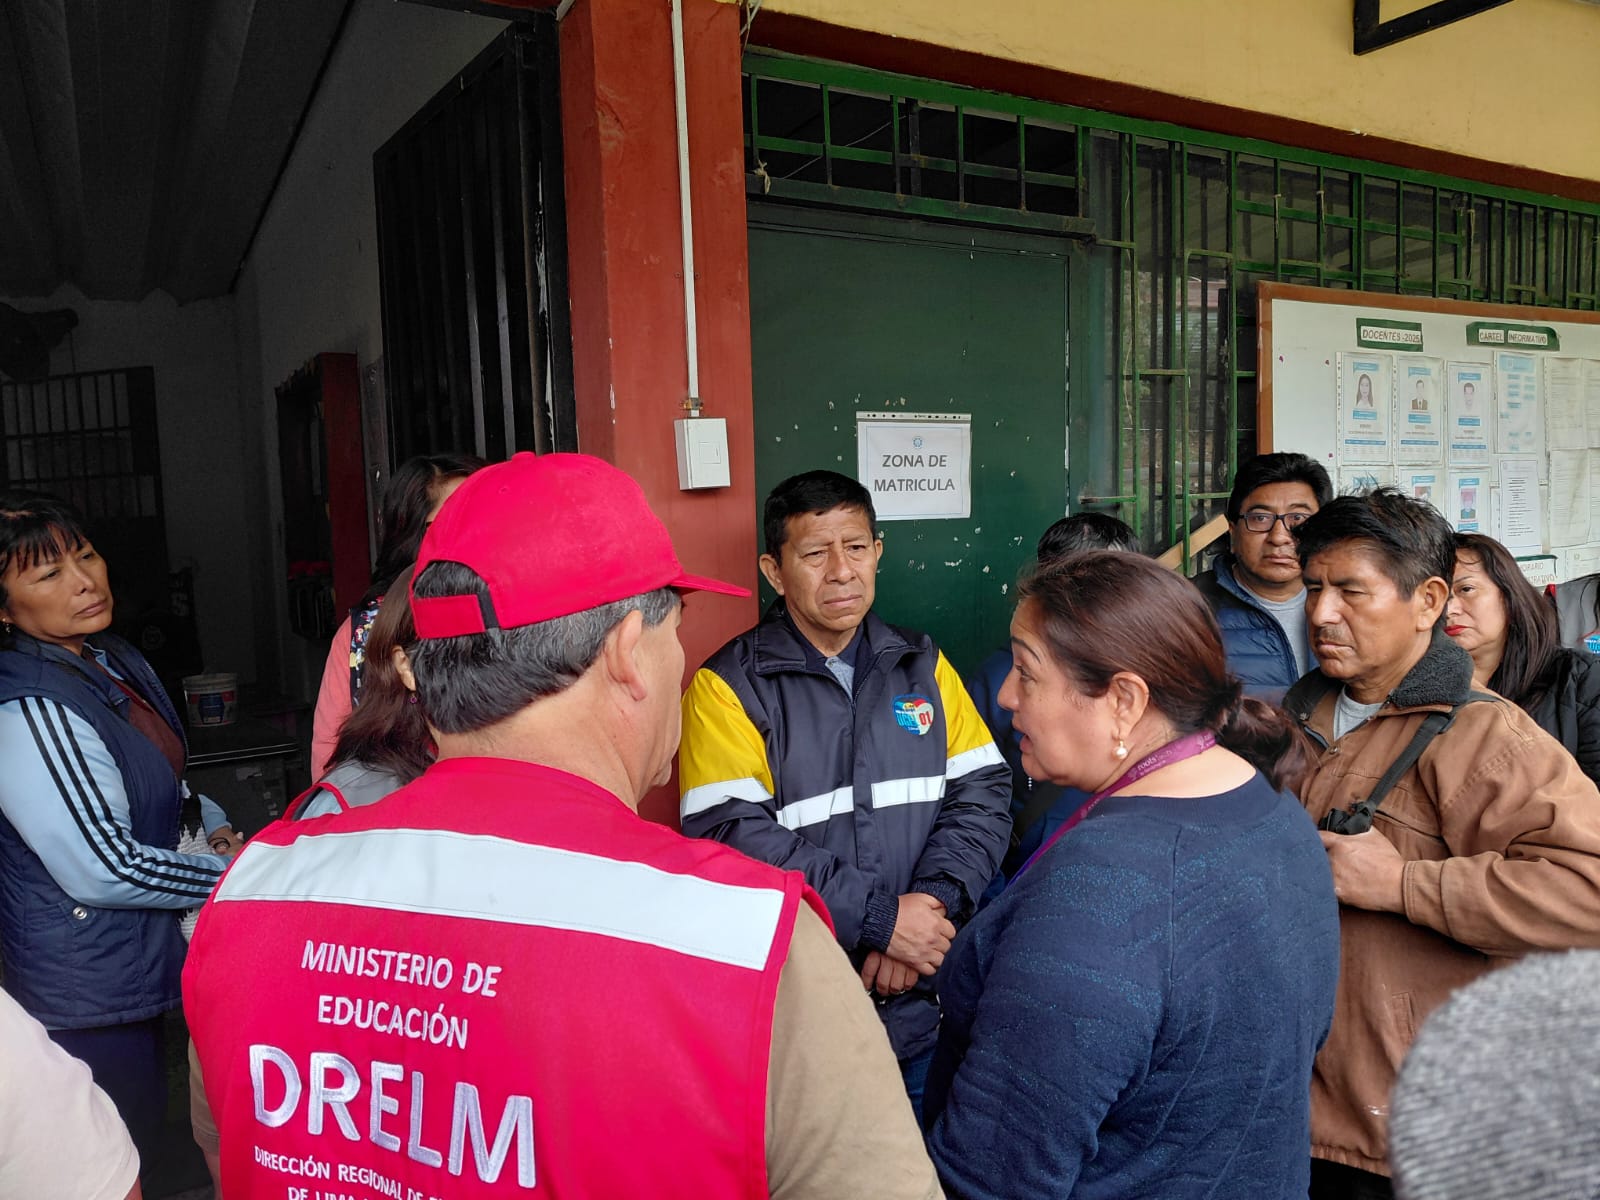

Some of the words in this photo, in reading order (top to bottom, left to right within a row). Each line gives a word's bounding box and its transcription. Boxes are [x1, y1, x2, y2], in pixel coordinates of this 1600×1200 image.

[1480, 332, 1503, 342] CARTEL
[1508, 333, 1547, 344] INFORMATIVO
[882, 454, 924, 467] ZONA
[928, 454, 948, 467] DE
[874, 479, 955, 492] MATRICULA
[919, 711, 932, 726] 01
[301, 940, 453, 989] MINISTERIO
[462, 963, 502, 998] DE
[318, 995, 468, 1049] EDUCACIÓN
[249, 1044, 536, 1189] DRELM
[254, 1145, 330, 1180] DIRECCIÓN
[338, 1164, 402, 1200] REGIONAL
